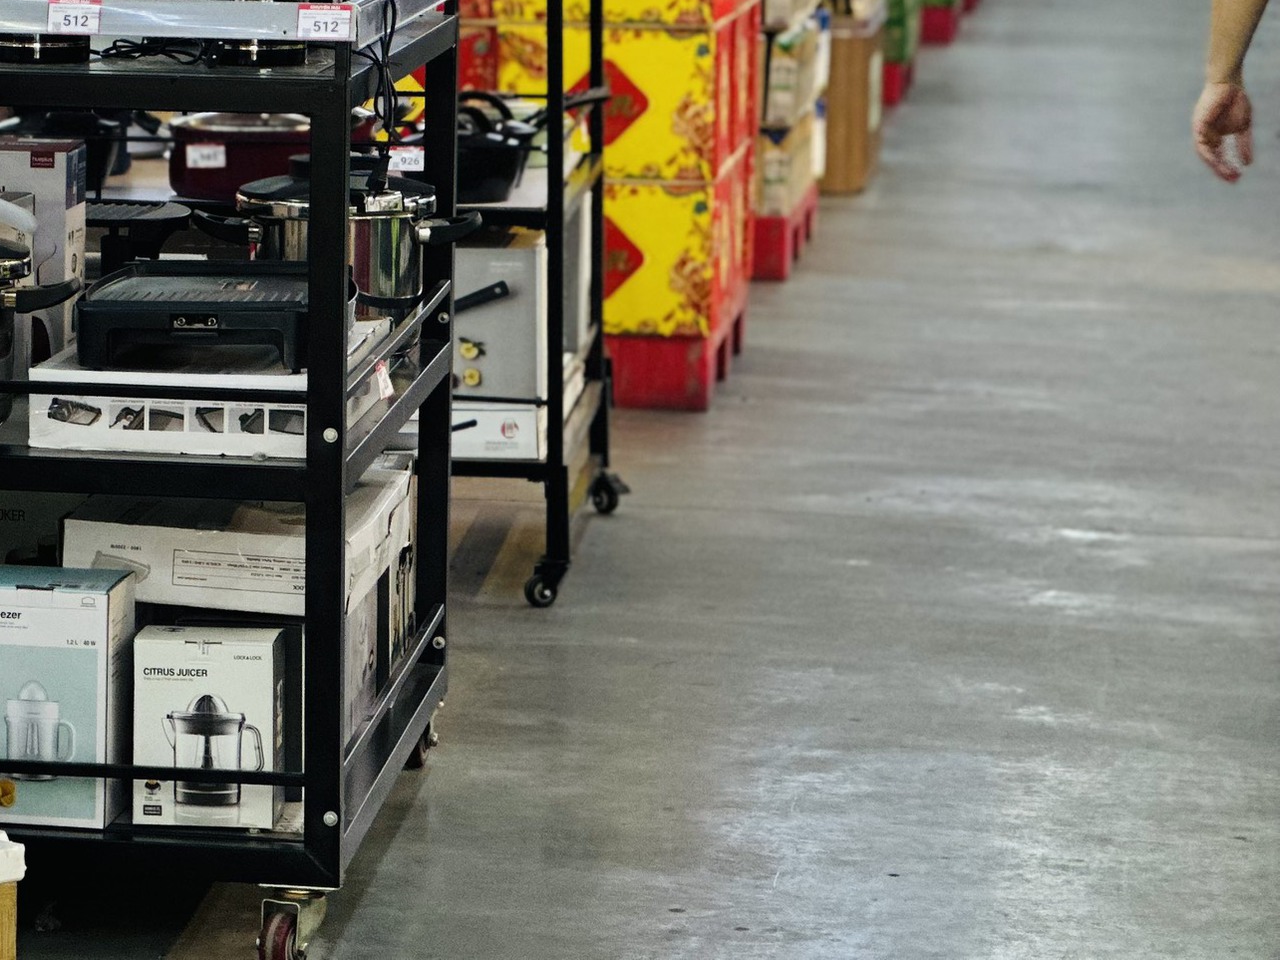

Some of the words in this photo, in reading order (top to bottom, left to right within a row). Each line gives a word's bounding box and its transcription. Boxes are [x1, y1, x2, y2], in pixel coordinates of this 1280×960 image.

[63, 14, 89, 27] 512
[313, 20, 339, 33] 512
[400, 155, 421, 167] 926
[143, 667, 176, 677] CITRUS
[176, 668, 209, 678] JUICER
